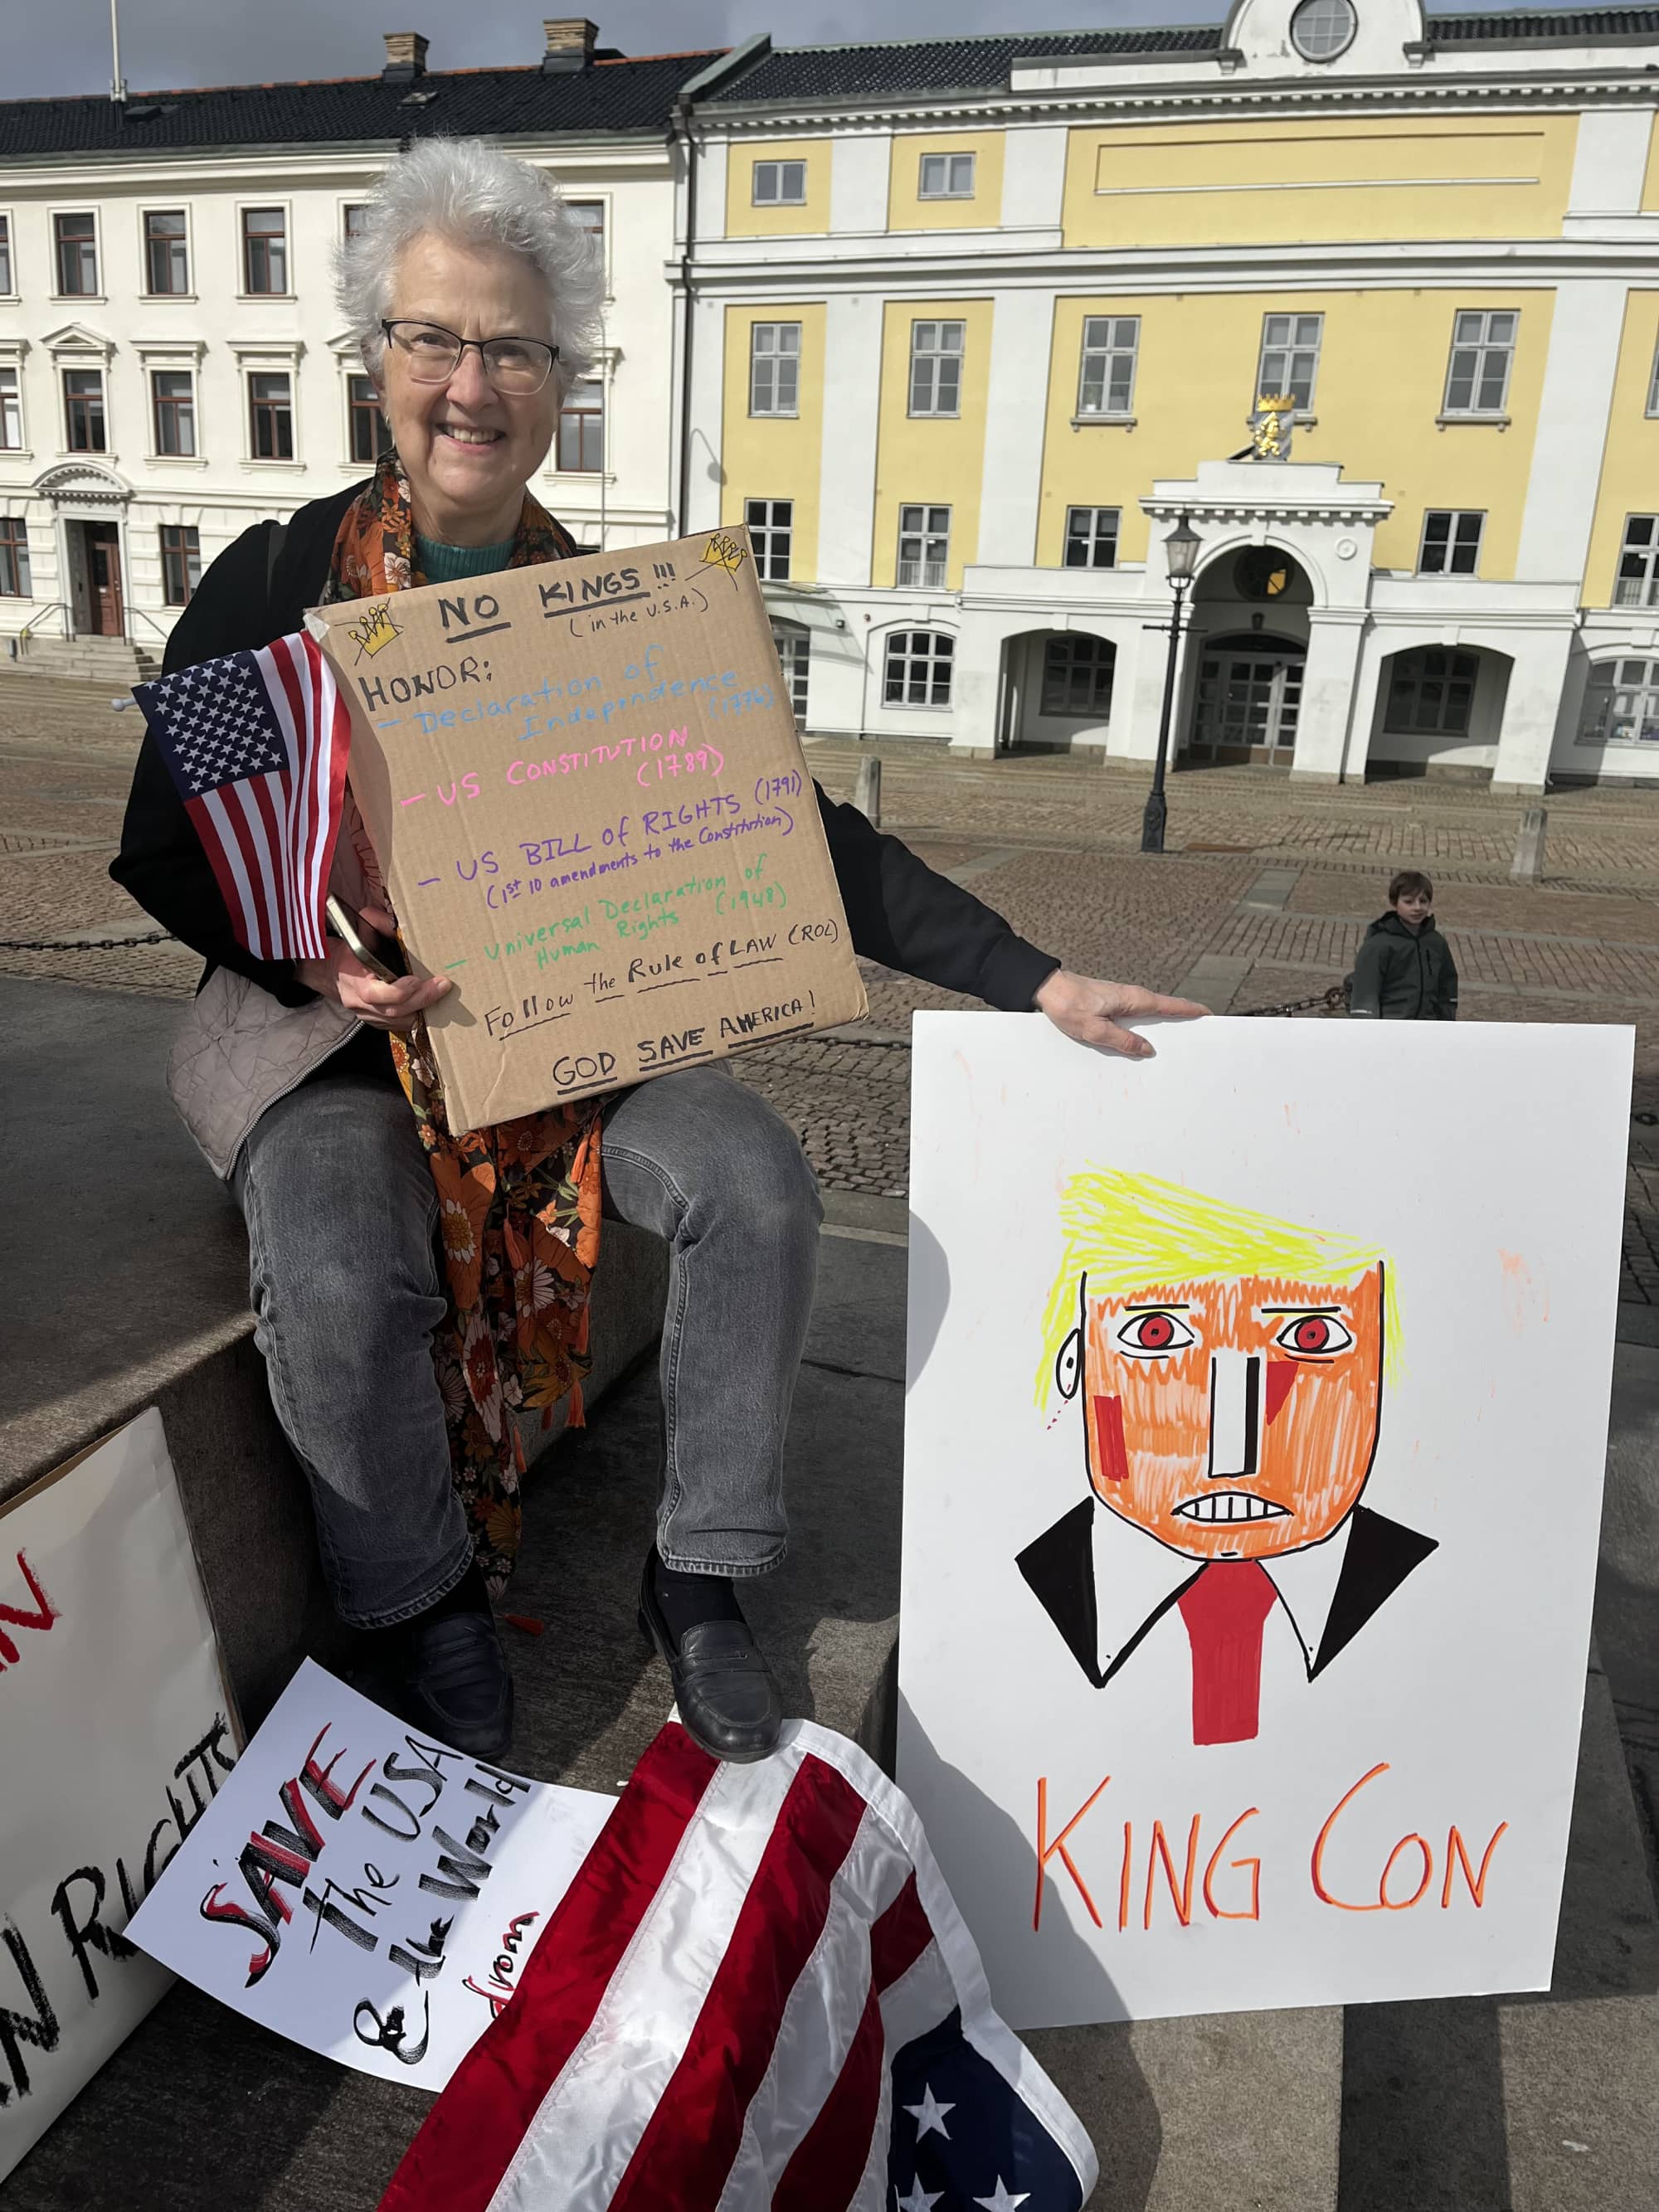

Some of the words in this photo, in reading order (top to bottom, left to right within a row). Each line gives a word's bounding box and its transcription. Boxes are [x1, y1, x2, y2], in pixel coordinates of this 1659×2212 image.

[438, 595, 499, 629] NO
[611, 608, 638, 626] the
[358, 656, 492, 712] HONOR:
[413, 676, 602, 734] Declaration
[624, 644, 664, 682] of
[518, 670, 737, 741] Independence
[709, 683, 775, 720] (1776)
[437, 772, 481, 807] US
[506, 725, 688, 785] CONSTITUTION
[637, 742, 725, 787] (1789)
[456, 851, 499, 881] US
[518, 833, 593, 866] BILL
[643, 794, 742, 835] RIGHTS
[754, 769, 803, 805] (1791)
[528, 878, 542, 895] 10
[549, 850, 639, 888] amendments
[643, 842, 662, 860] to
[668, 837, 695, 853] the
[484, 905, 591, 960] Universal
[596, 875, 727, 921] Declaration
[744, 853, 768, 880] of
[536, 940, 601, 970] Human
[615, 907, 680, 941] Rights
[716, 881, 787, 916] (1948)
[484, 993, 574, 1037] Follow
[583, 972, 616, 994] the
[627, 954, 684, 984] Rule
[695, 941, 723, 966] of
[729, 933, 777, 956] LAW
[787, 918, 839, 946] (ROL)
[552, 1052, 618, 1087] GOD
[636, 1027, 707, 1063] SAVE
[719, 989, 816, 1038] AMERICA!
[360, 1734, 465, 1843] USA
[418, 1762, 531, 1901] World
[200, 1721, 377, 1989] SAVE
[1032, 1774, 1261, 1933] KING
[388, 1913, 455, 1987] the
[461, 1910, 541, 2019] from
[353, 1990, 429, 2065] &
